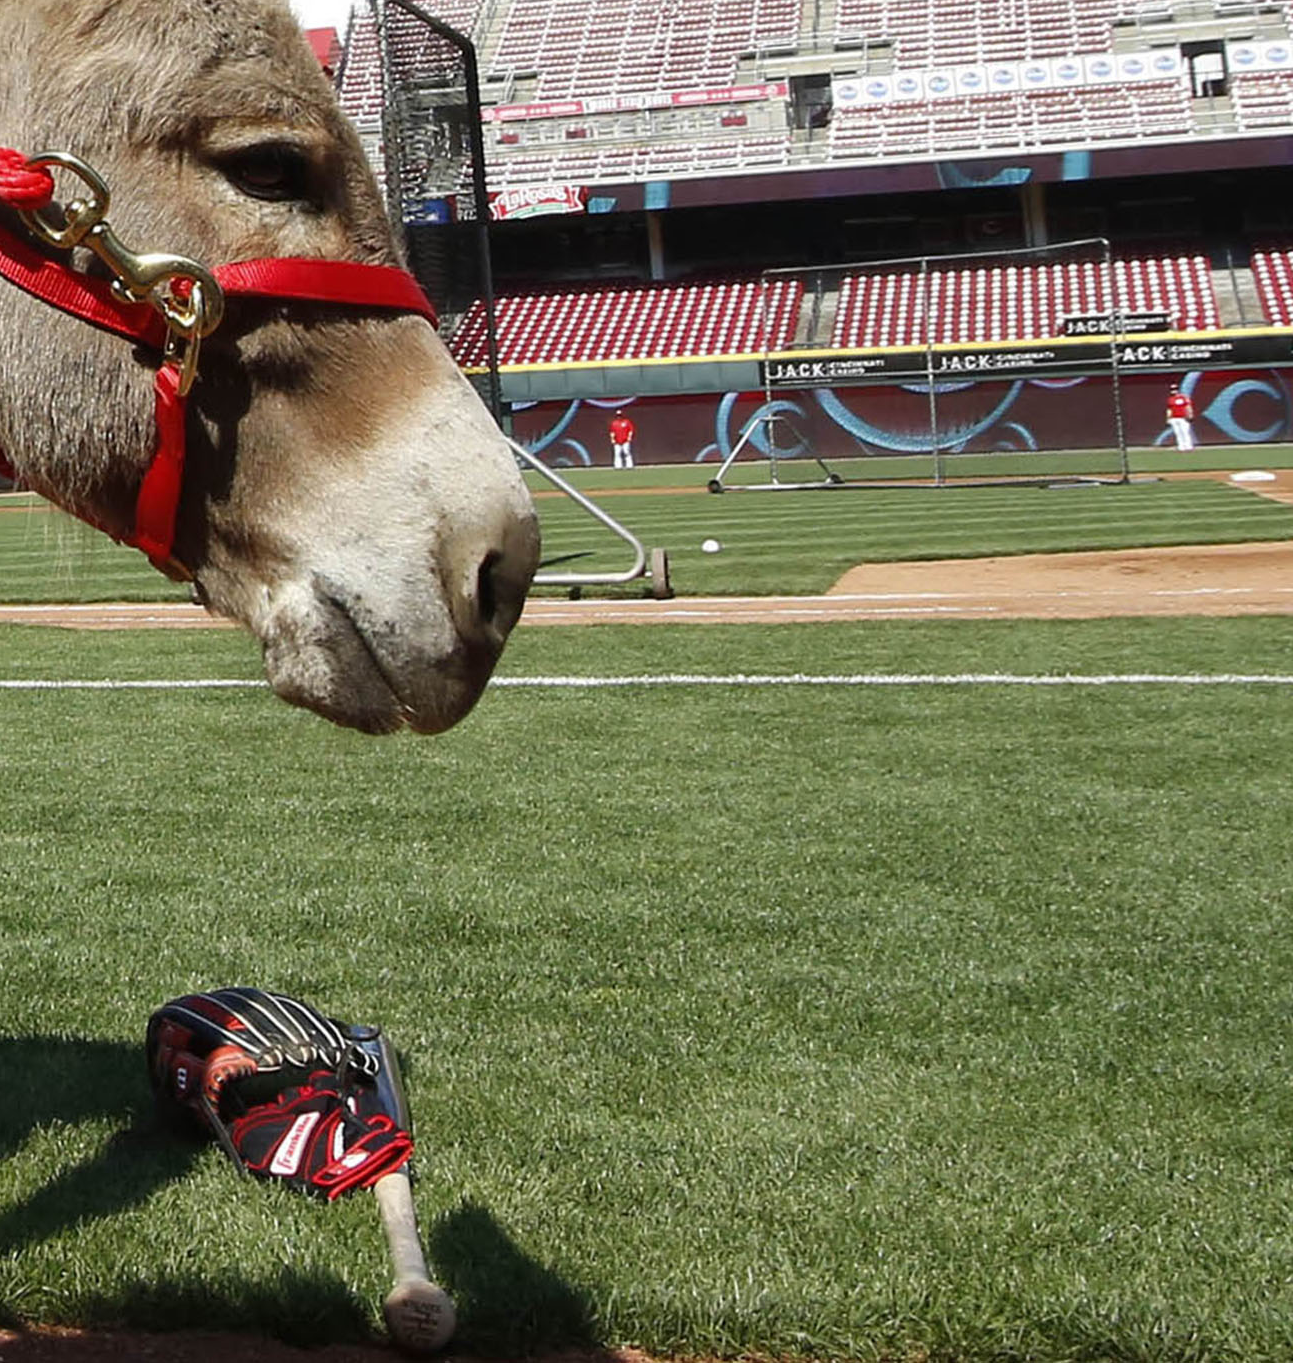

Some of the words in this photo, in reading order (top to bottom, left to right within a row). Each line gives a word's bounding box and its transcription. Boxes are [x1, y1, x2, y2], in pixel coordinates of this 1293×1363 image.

[1066, 322, 1111, 334] JACK
[940, 354, 991, 371] JACK
[776, 363, 825, 378] JACK
